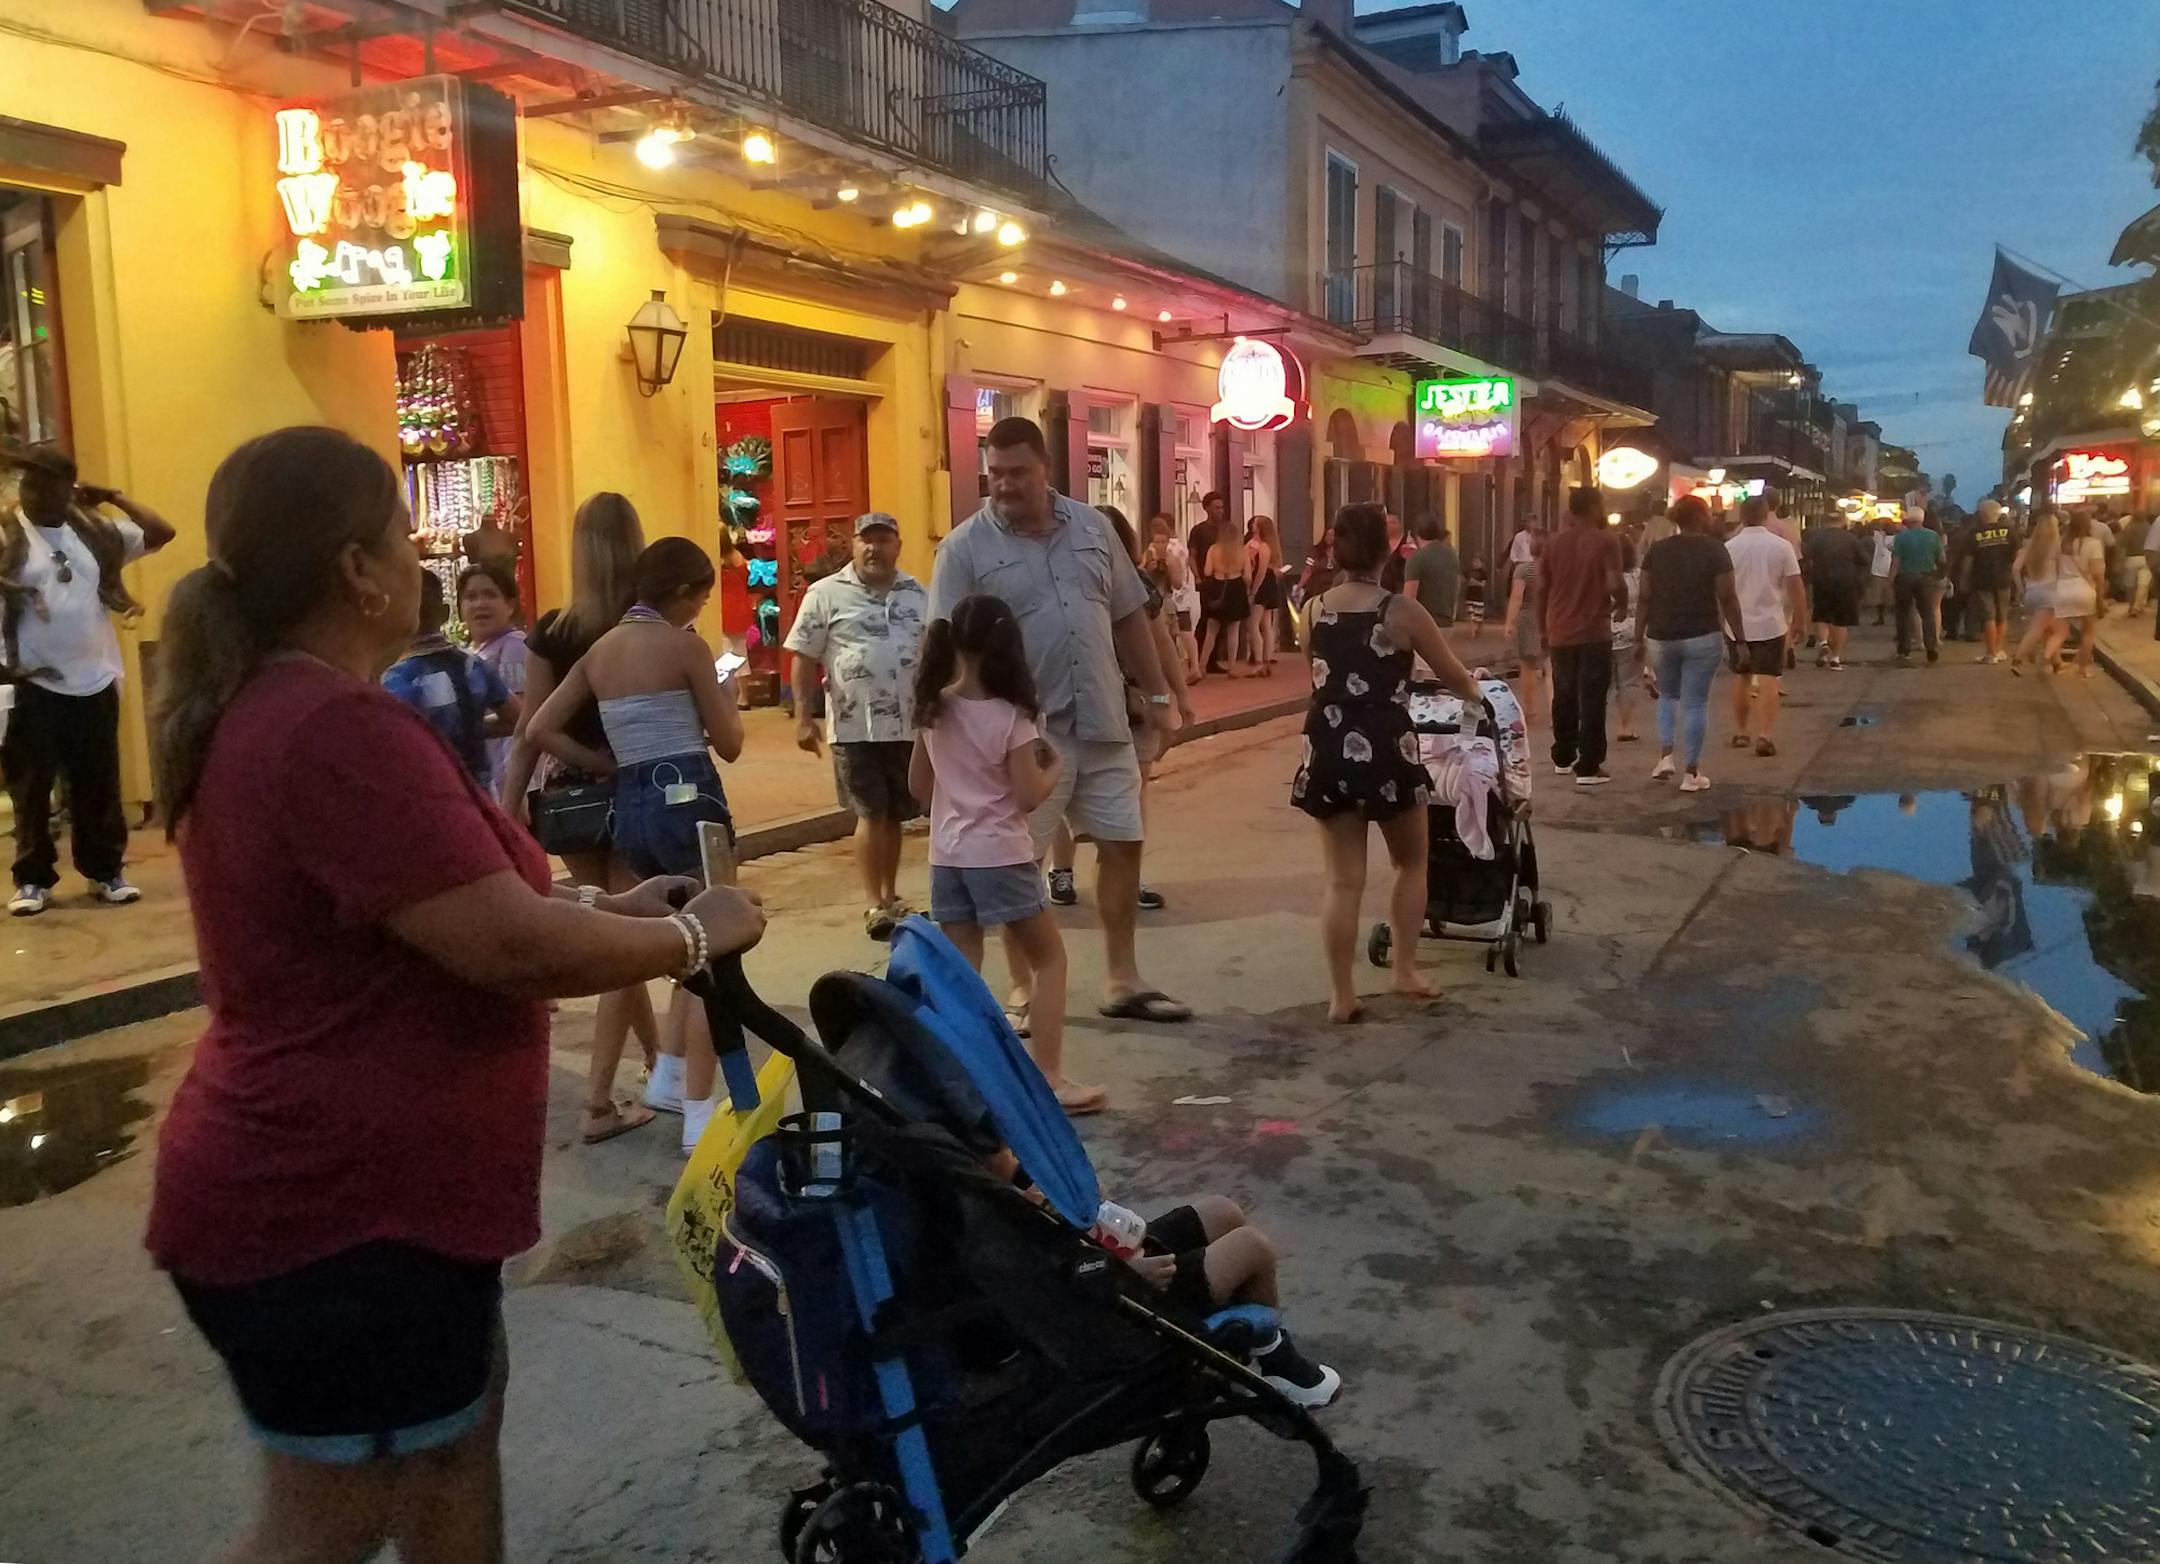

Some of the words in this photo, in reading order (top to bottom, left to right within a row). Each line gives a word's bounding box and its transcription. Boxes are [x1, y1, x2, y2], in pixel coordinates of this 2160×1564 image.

[352, 292, 383, 305] Spice
[386, 290, 398, 302] In
[401, 289, 429, 301] Your
[433, 286, 456, 298] Life
